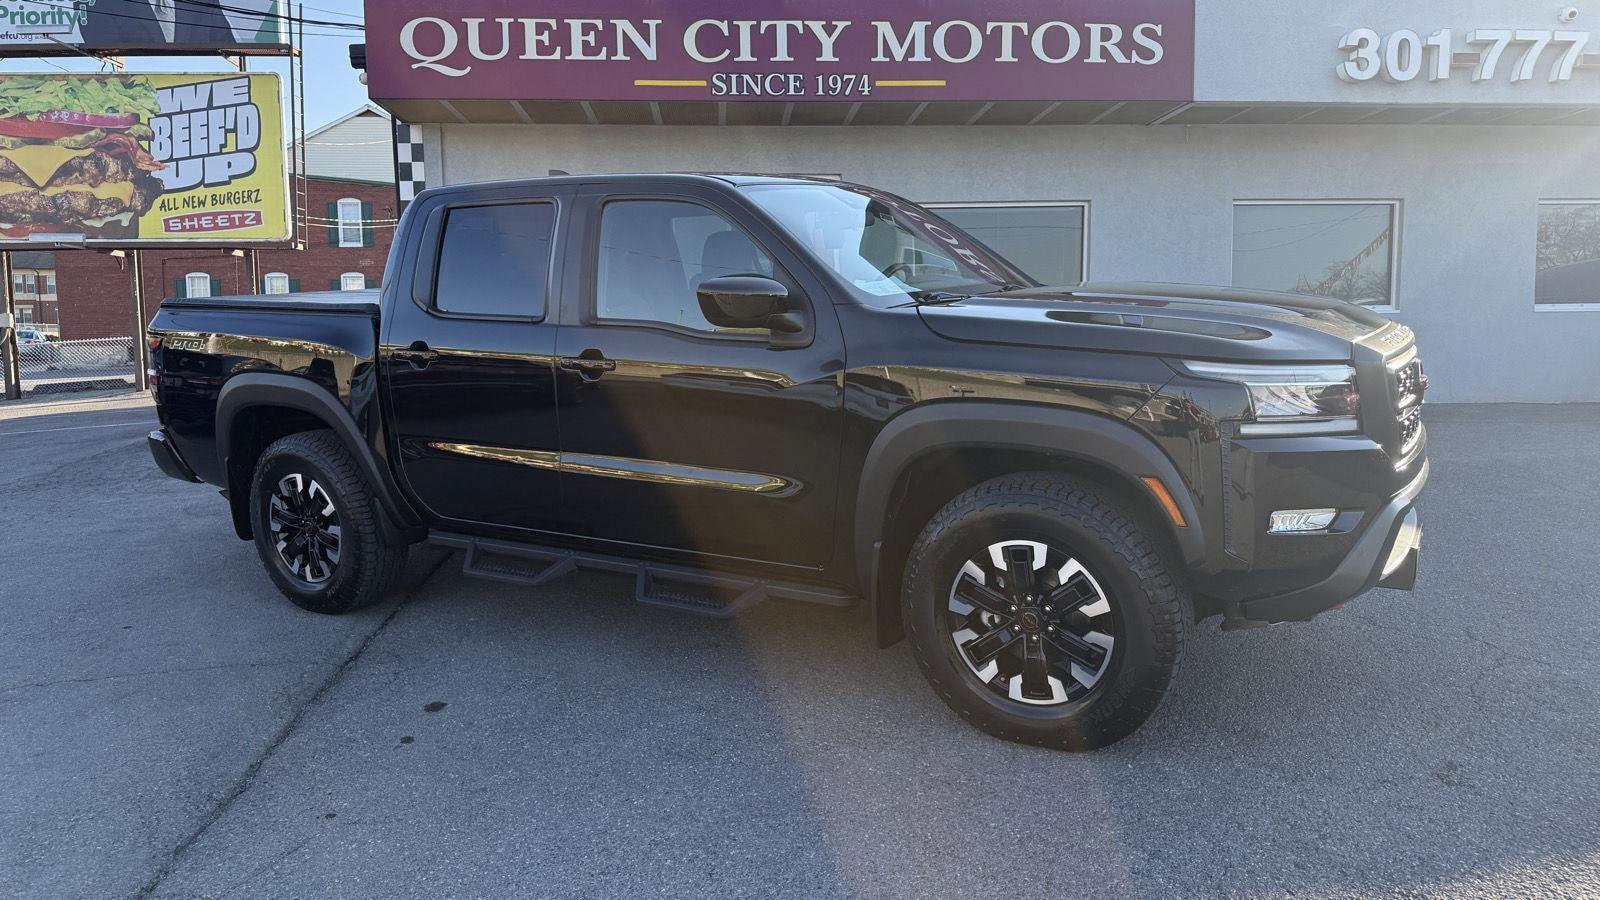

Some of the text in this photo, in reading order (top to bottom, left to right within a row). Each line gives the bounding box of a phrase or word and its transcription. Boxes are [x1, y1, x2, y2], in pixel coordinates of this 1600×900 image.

[399, 17, 1164, 77] QUEEN CITY MOTORS
[156, 77, 250, 115] WE
[712, 73, 872, 96] SINCE 1974
[149, 104, 260, 161] BEEF'D
[151, 152, 256, 192] UP
[159, 188, 262, 212] ALL NEW BURGERZ
[168, 212, 257, 231] SHEETZ
